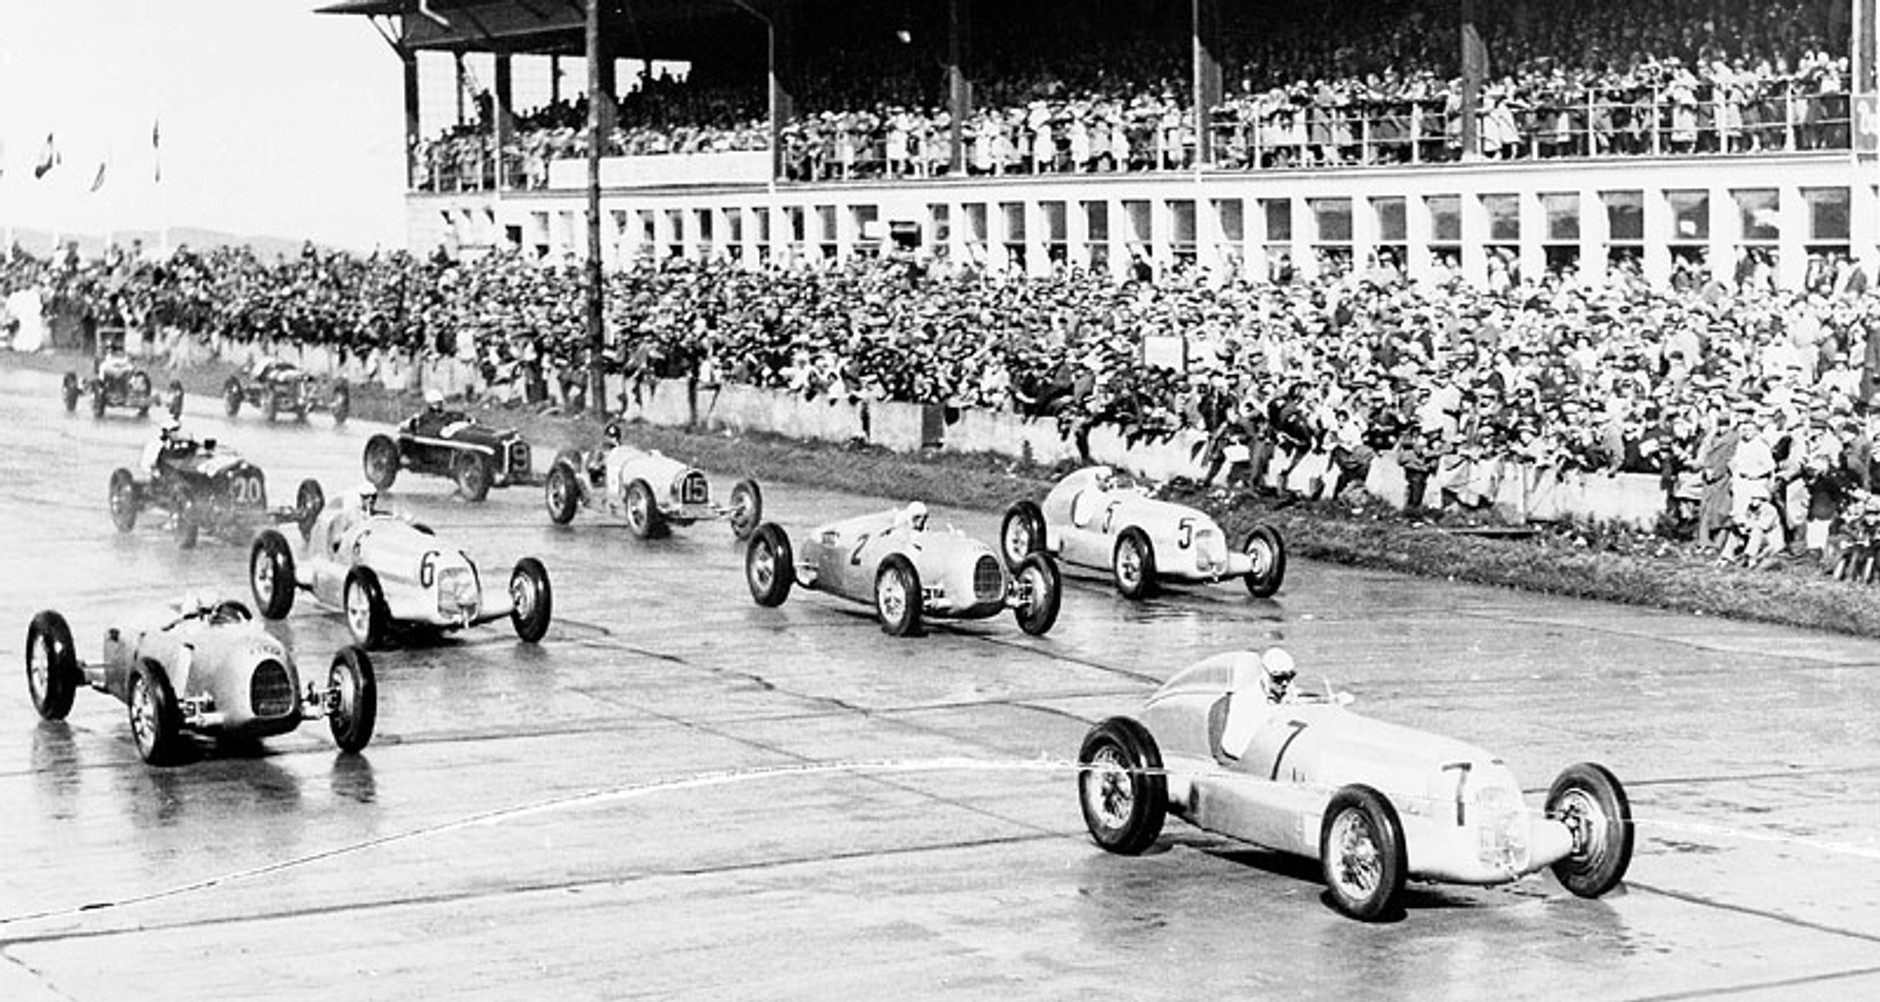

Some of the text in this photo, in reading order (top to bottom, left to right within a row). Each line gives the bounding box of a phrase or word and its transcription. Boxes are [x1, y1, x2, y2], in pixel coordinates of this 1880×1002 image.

[512, 444, 528, 471] 9
[234, 477, 261, 502] 20
[686, 477, 706, 501] 15
[1179, 517, 1196, 549] 5
[851, 533, 869, 566] 2
[420, 550, 440, 589] 6
[1270, 720, 1308, 781] 7
[1442, 762, 1472, 826] 7
